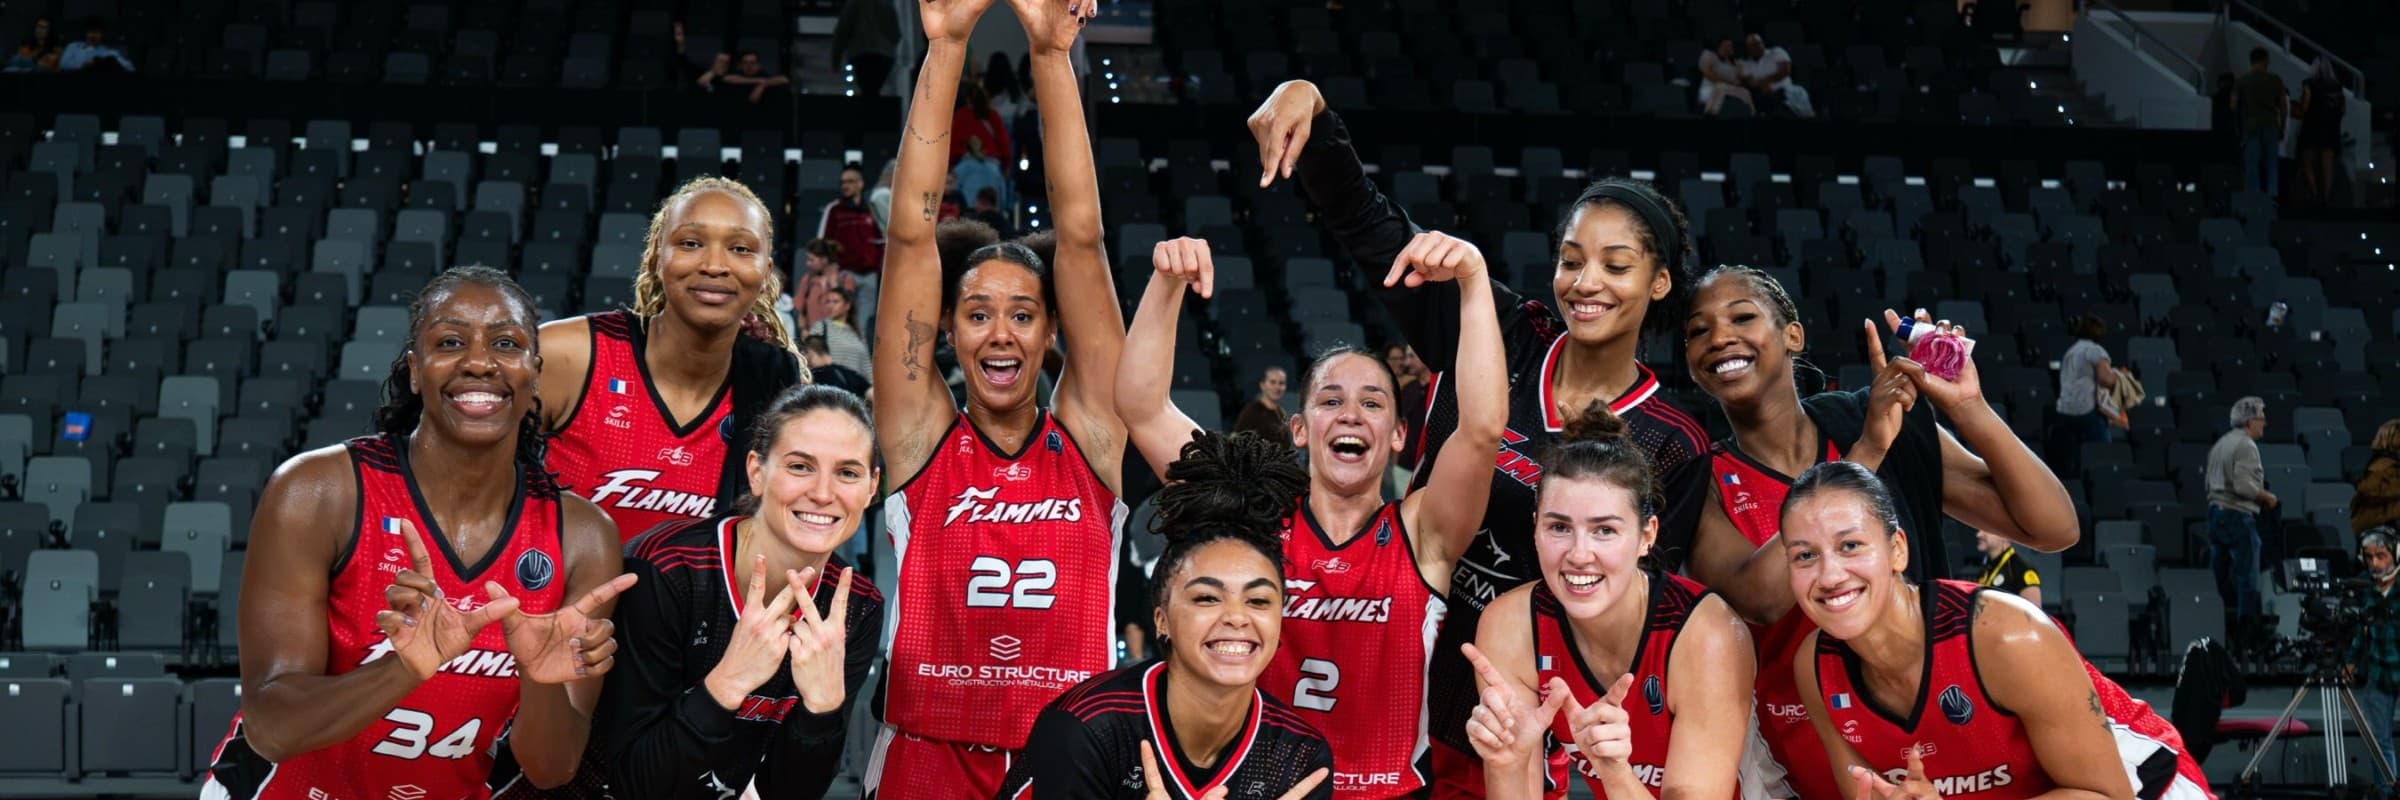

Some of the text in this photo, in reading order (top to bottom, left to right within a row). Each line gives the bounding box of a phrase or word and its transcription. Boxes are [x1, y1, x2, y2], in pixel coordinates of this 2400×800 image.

[604, 416, 631, 429] SKILLS
[590, 468, 718, 518] FLAMME
[943, 486, 1081, 527] FLAMMES
[966, 556, 1057, 609] 22
[918, 663, 1091, 684] EURO STRUCTURE
[1293, 658, 1340, 711] 2
[372, 708, 482, 760] 34
[1333, 772, 1400, 785] CTURE
